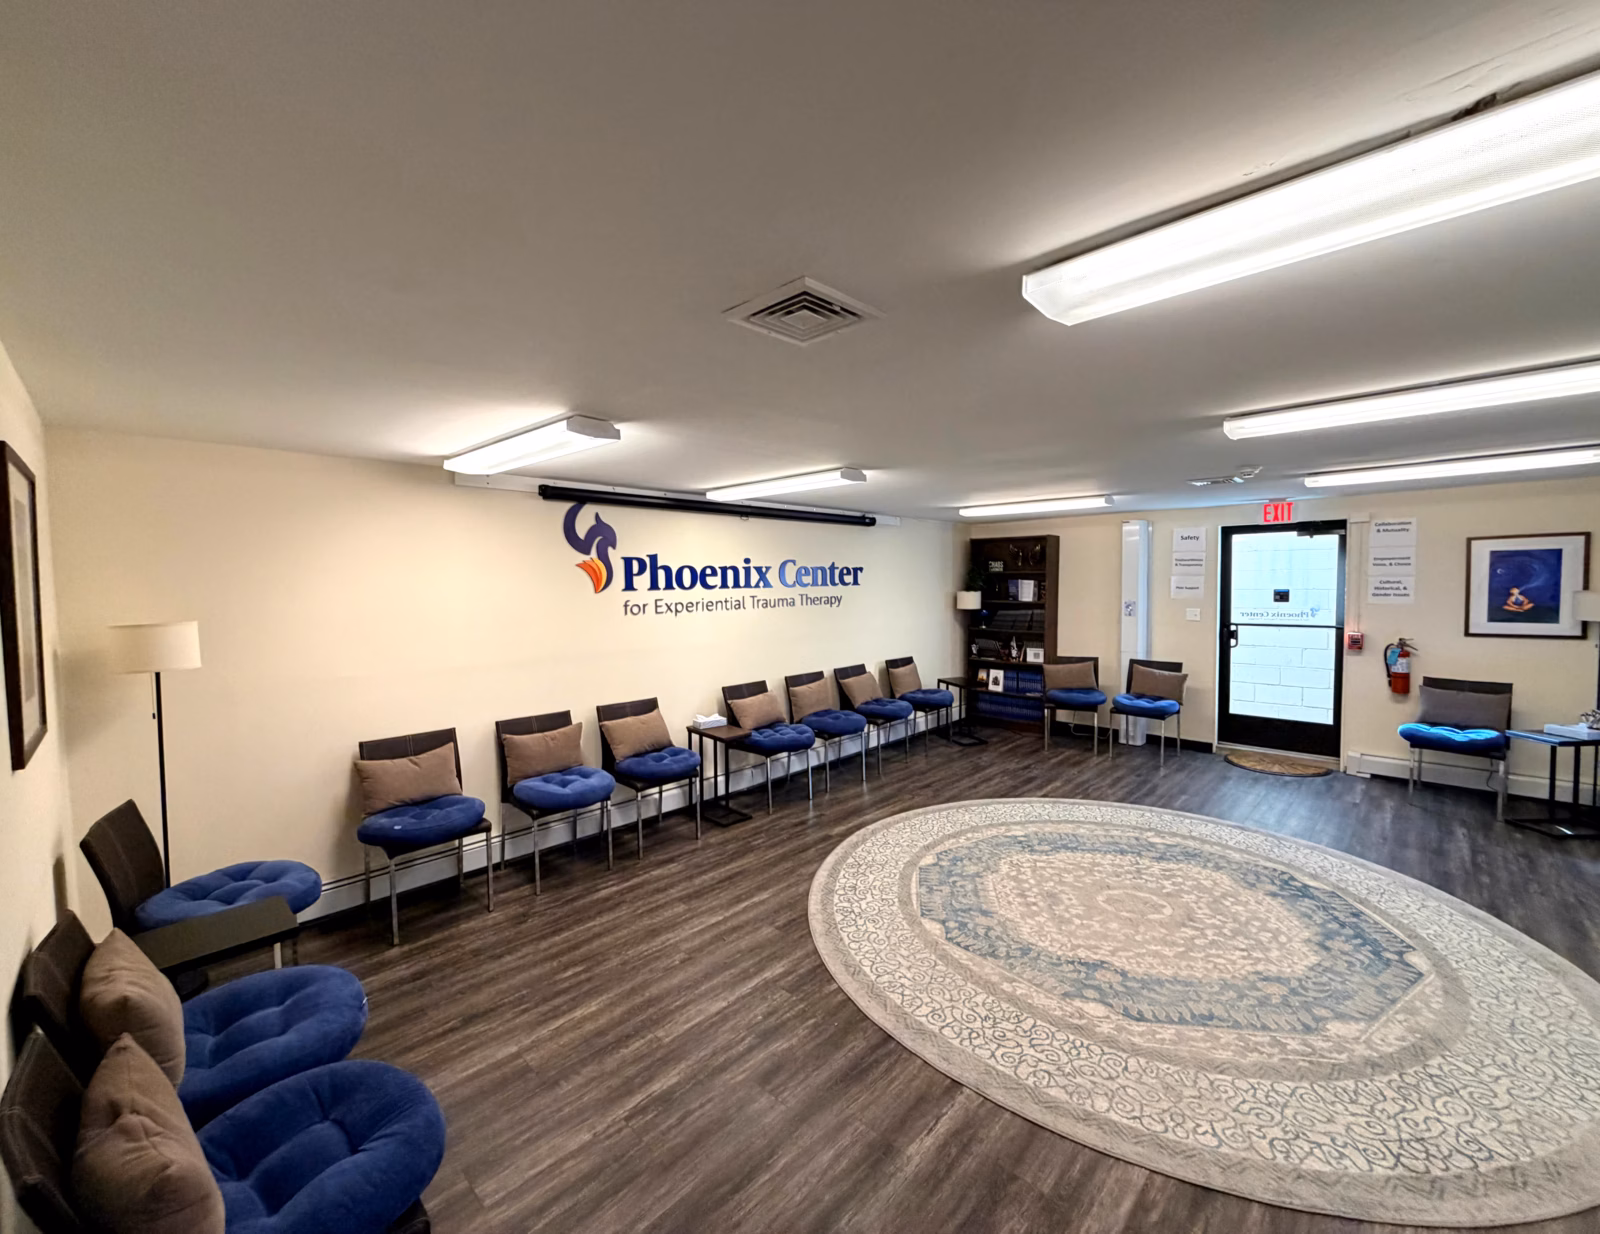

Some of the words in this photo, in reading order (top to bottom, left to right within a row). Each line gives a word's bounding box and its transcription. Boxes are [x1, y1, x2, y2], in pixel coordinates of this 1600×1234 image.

[1264, 502, 1294, 523] EXIT
[621, 553, 773, 592] Phoenix
[778, 559, 864, 588] Center
[623, 600, 648, 616] for
[654, 596, 746, 617] Experiential
[750, 594, 796, 610] Trauma
[798, 593, 843, 608] Therapy
